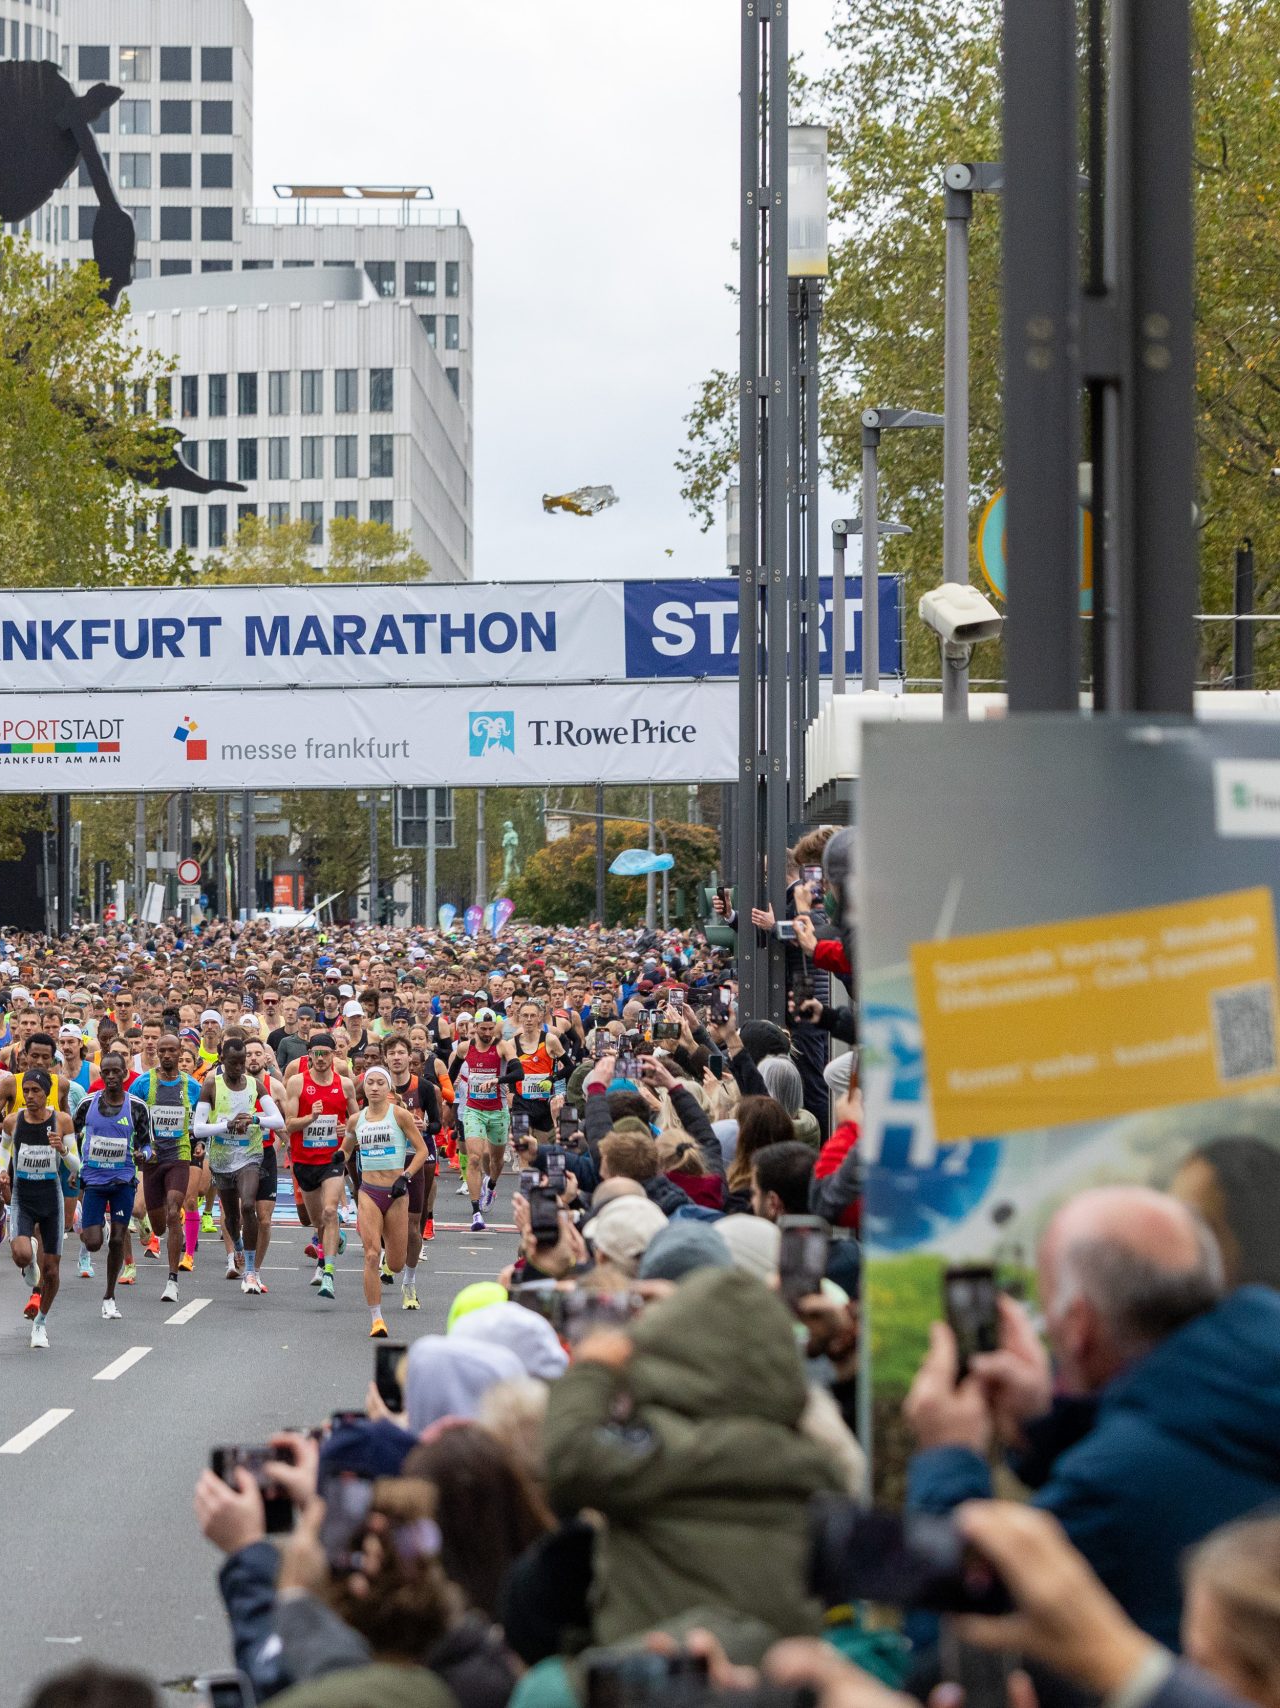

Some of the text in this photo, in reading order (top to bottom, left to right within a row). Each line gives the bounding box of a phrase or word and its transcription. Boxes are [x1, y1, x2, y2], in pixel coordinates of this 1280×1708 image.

[651, 598, 863, 657] STT
[245, 611, 557, 657] MARATHON
[221, 736, 410, 761] messe frankfurt
[65, 755, 85, 764] AM
[89, 754, 121, 764] MAIN
[307, 1126, 334, 1137] PACE M
[373, 1133, 391, 1143] ANNA
[23, 1157, 51, 1169] FILIMON
